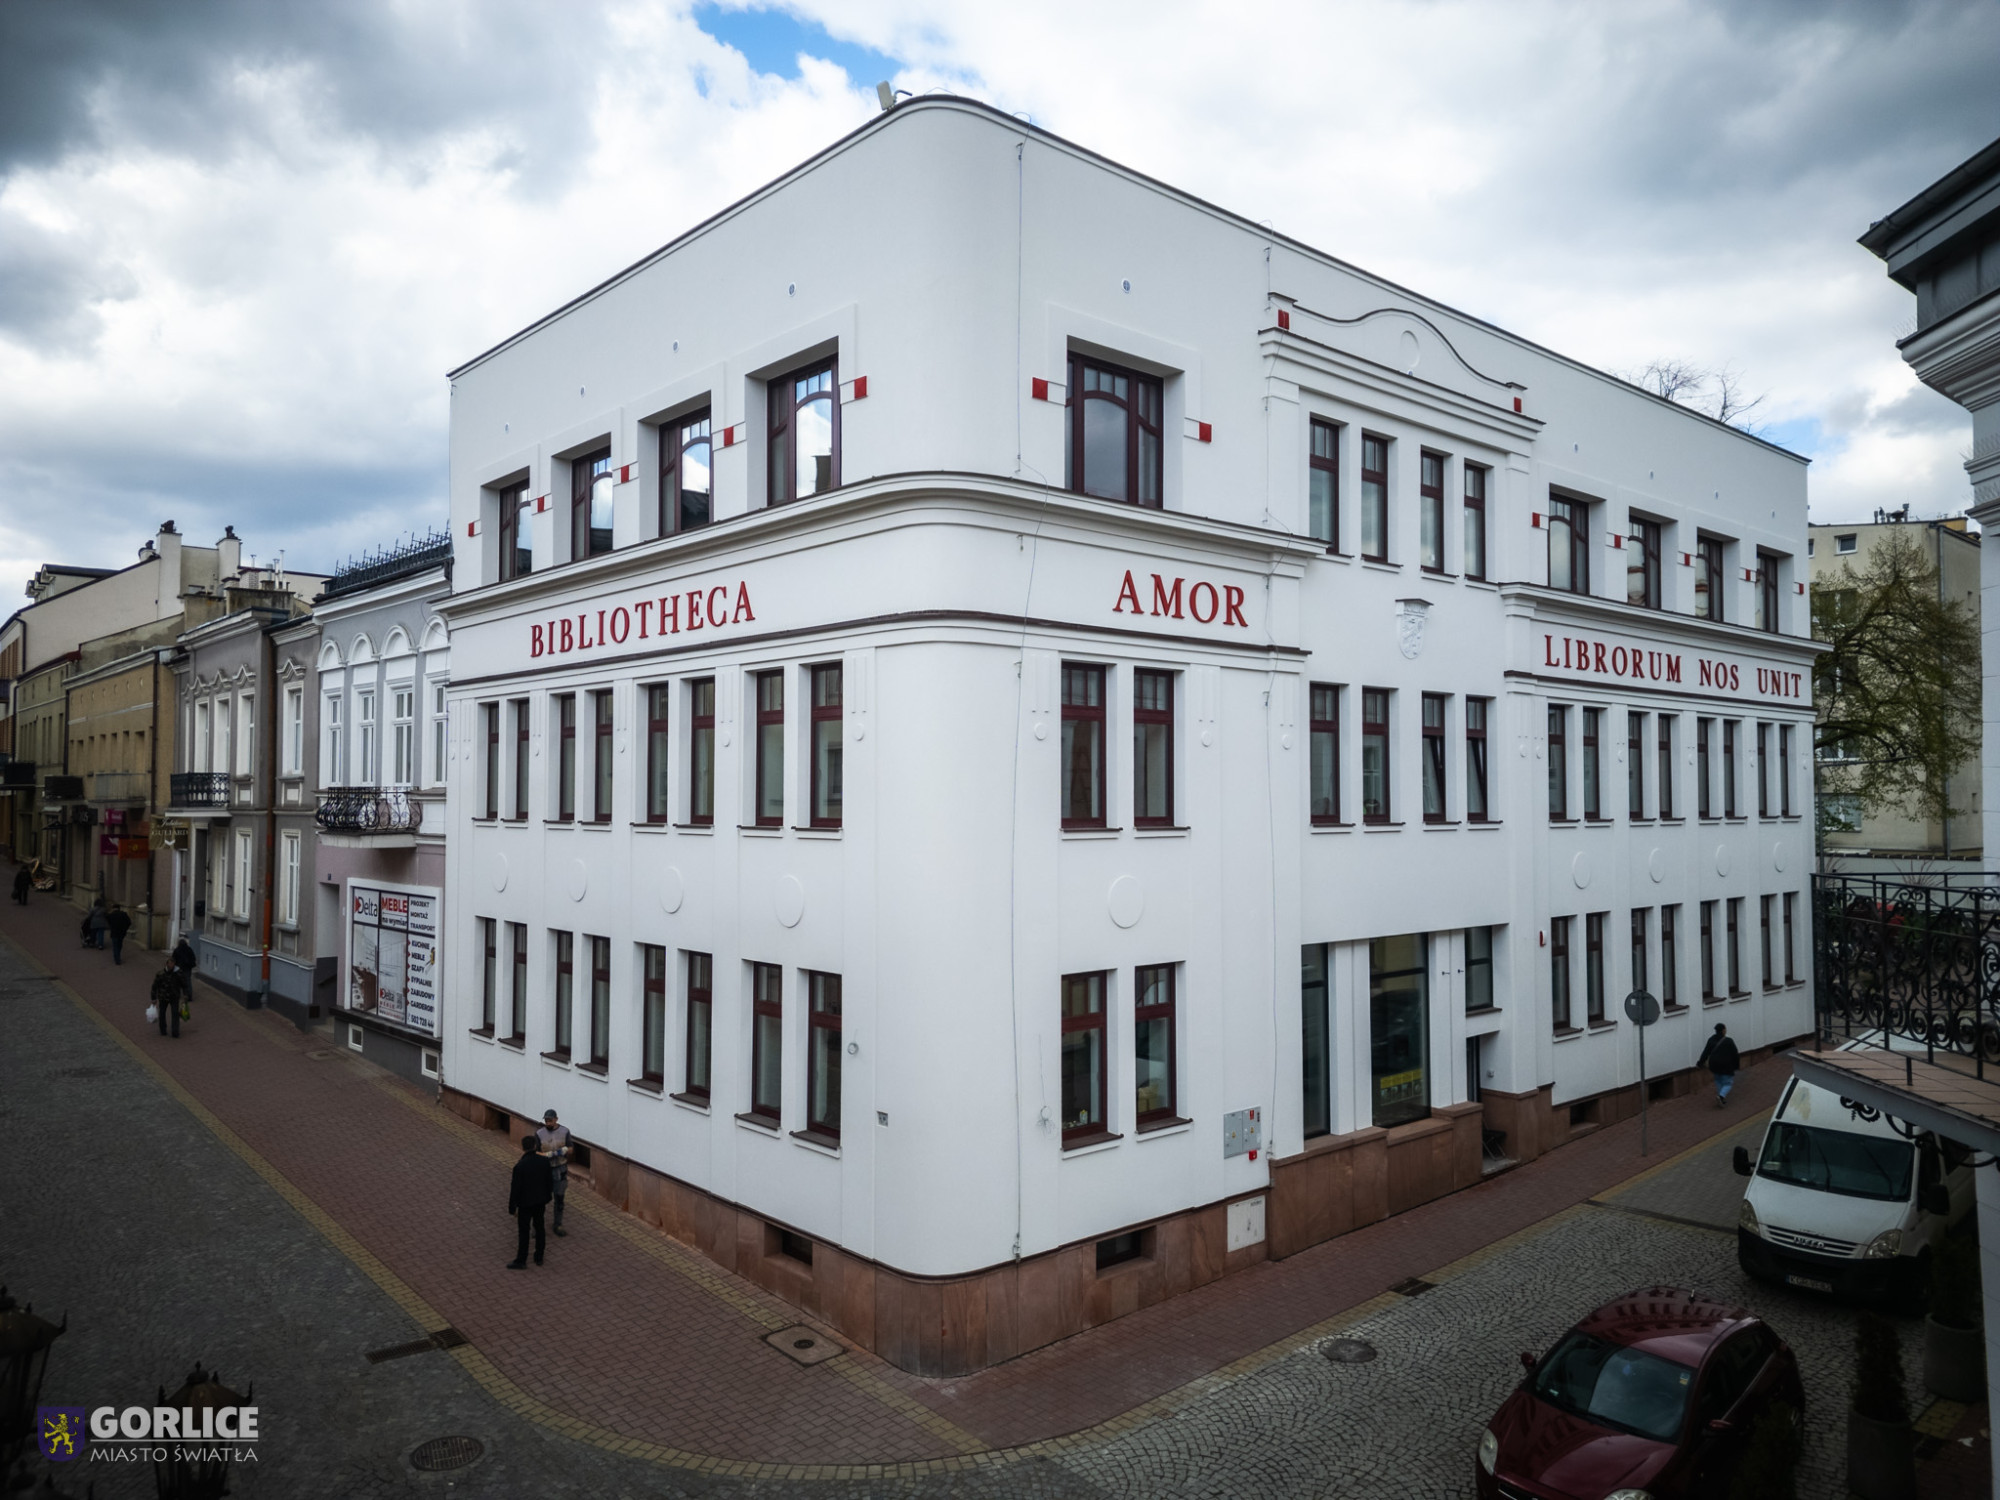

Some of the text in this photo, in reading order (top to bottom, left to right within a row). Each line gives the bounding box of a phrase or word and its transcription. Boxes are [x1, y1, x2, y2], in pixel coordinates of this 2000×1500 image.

[1112, 569, 1249, 628] AMOR
[530, 580, 756, 658] BIBLIOTHECA
[1544, 634, 1802, 698] LIBRORUM NOS UNIT
[357, 896, 378, 917] Delta
[381, 896, 408, 914] MEBLE
[410, 899, 430, 908] PROJEKT
[410, 911, 429, 920] MONTAŻ
[410, 922, 435, 932] TRANSPORT
[411, 940, 430, 949] KUCHNIE
[411, 952, 425, 961] MEBLE
[411, 964, 425, 973] SZAFY
[410, 988, 435, 1000] ZABUDOWY
